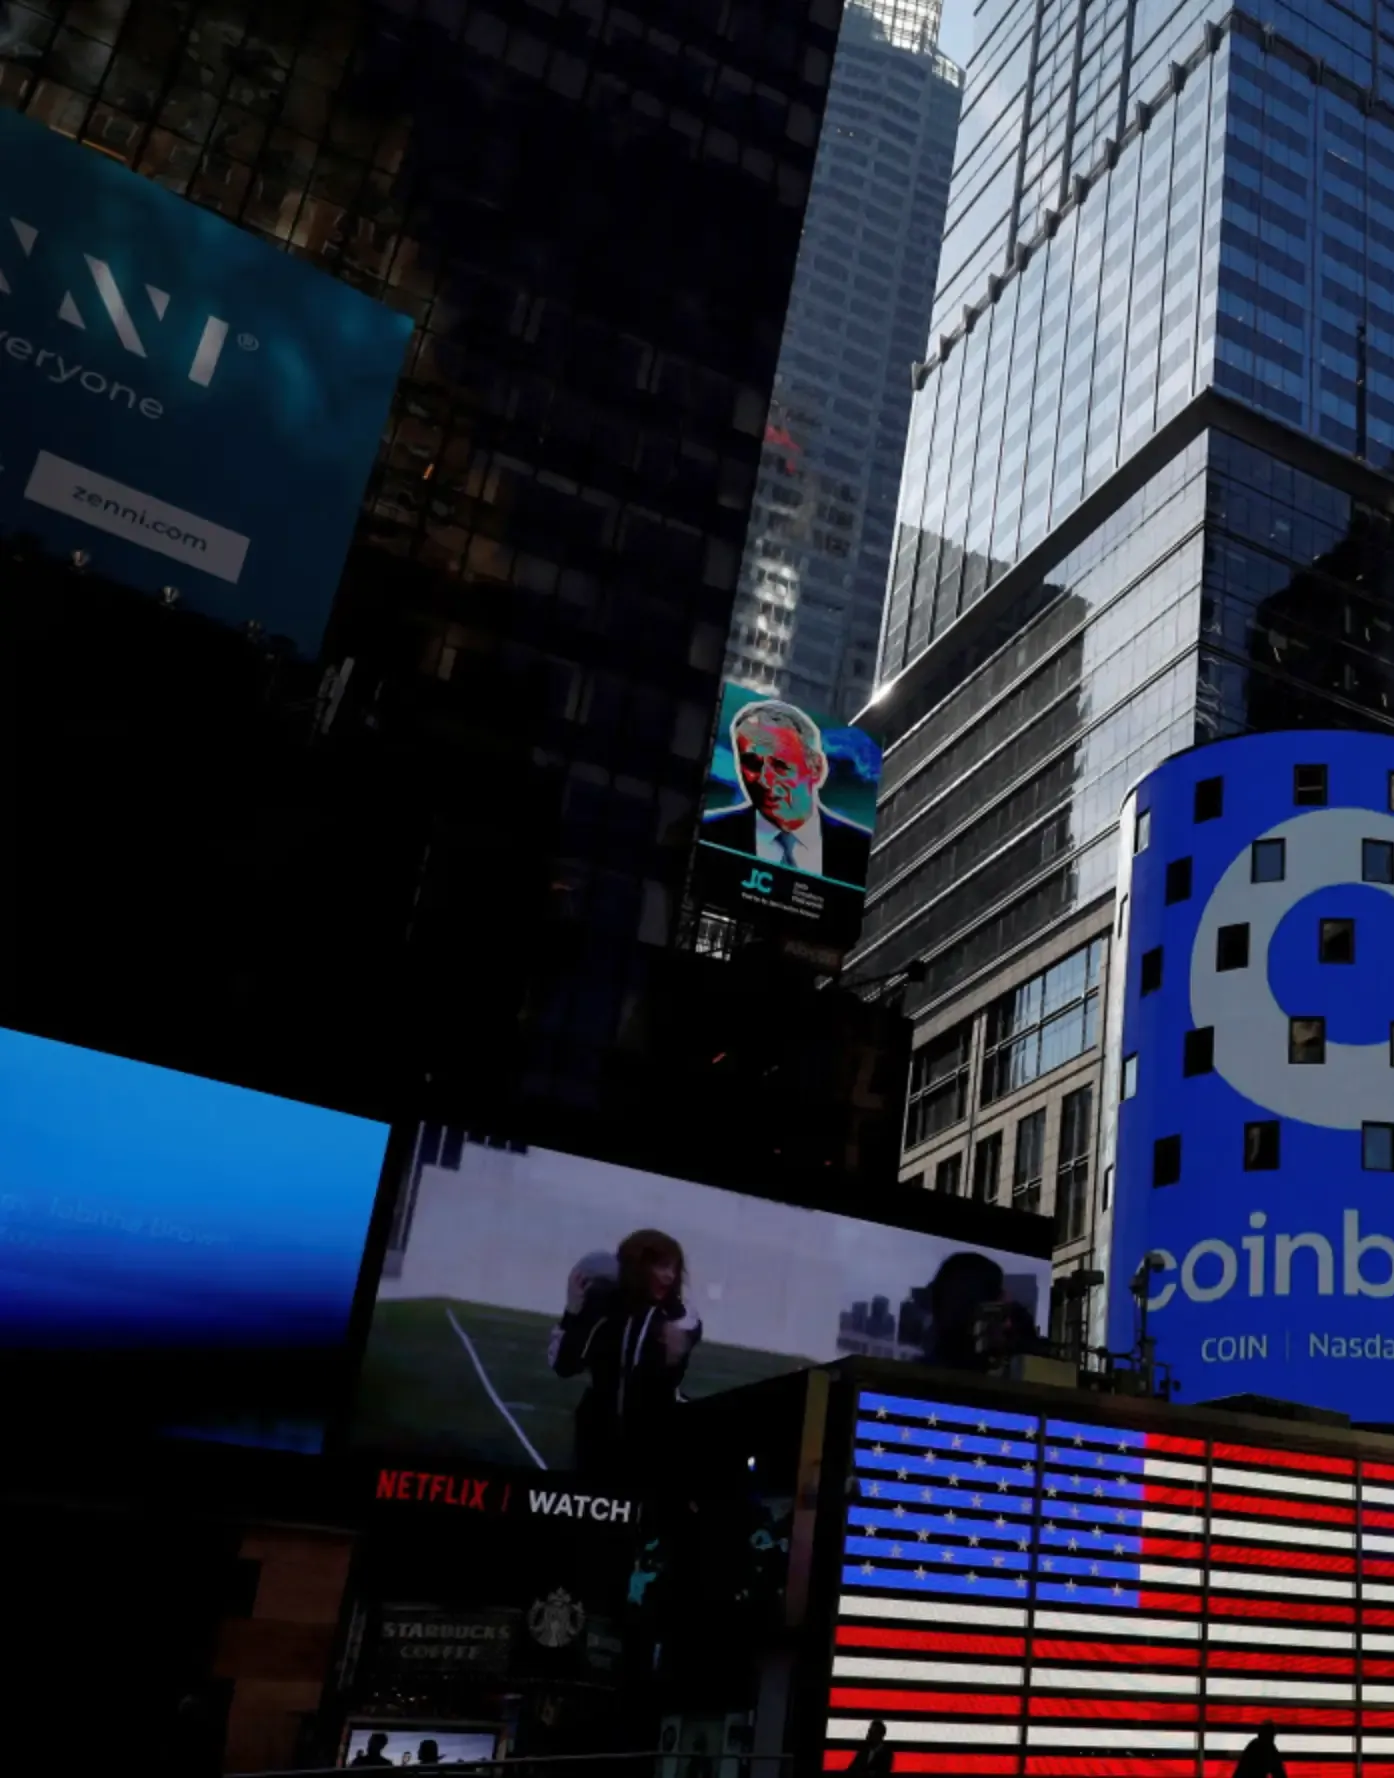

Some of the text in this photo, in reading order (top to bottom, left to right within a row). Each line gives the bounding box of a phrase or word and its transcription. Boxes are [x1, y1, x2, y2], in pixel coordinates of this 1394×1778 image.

[72, 485, 208, 552] zenni.com
[1201, 1335, 1268, 1363] COIN
[374, 1468, 632, 1524] NETFLIX WATCH
